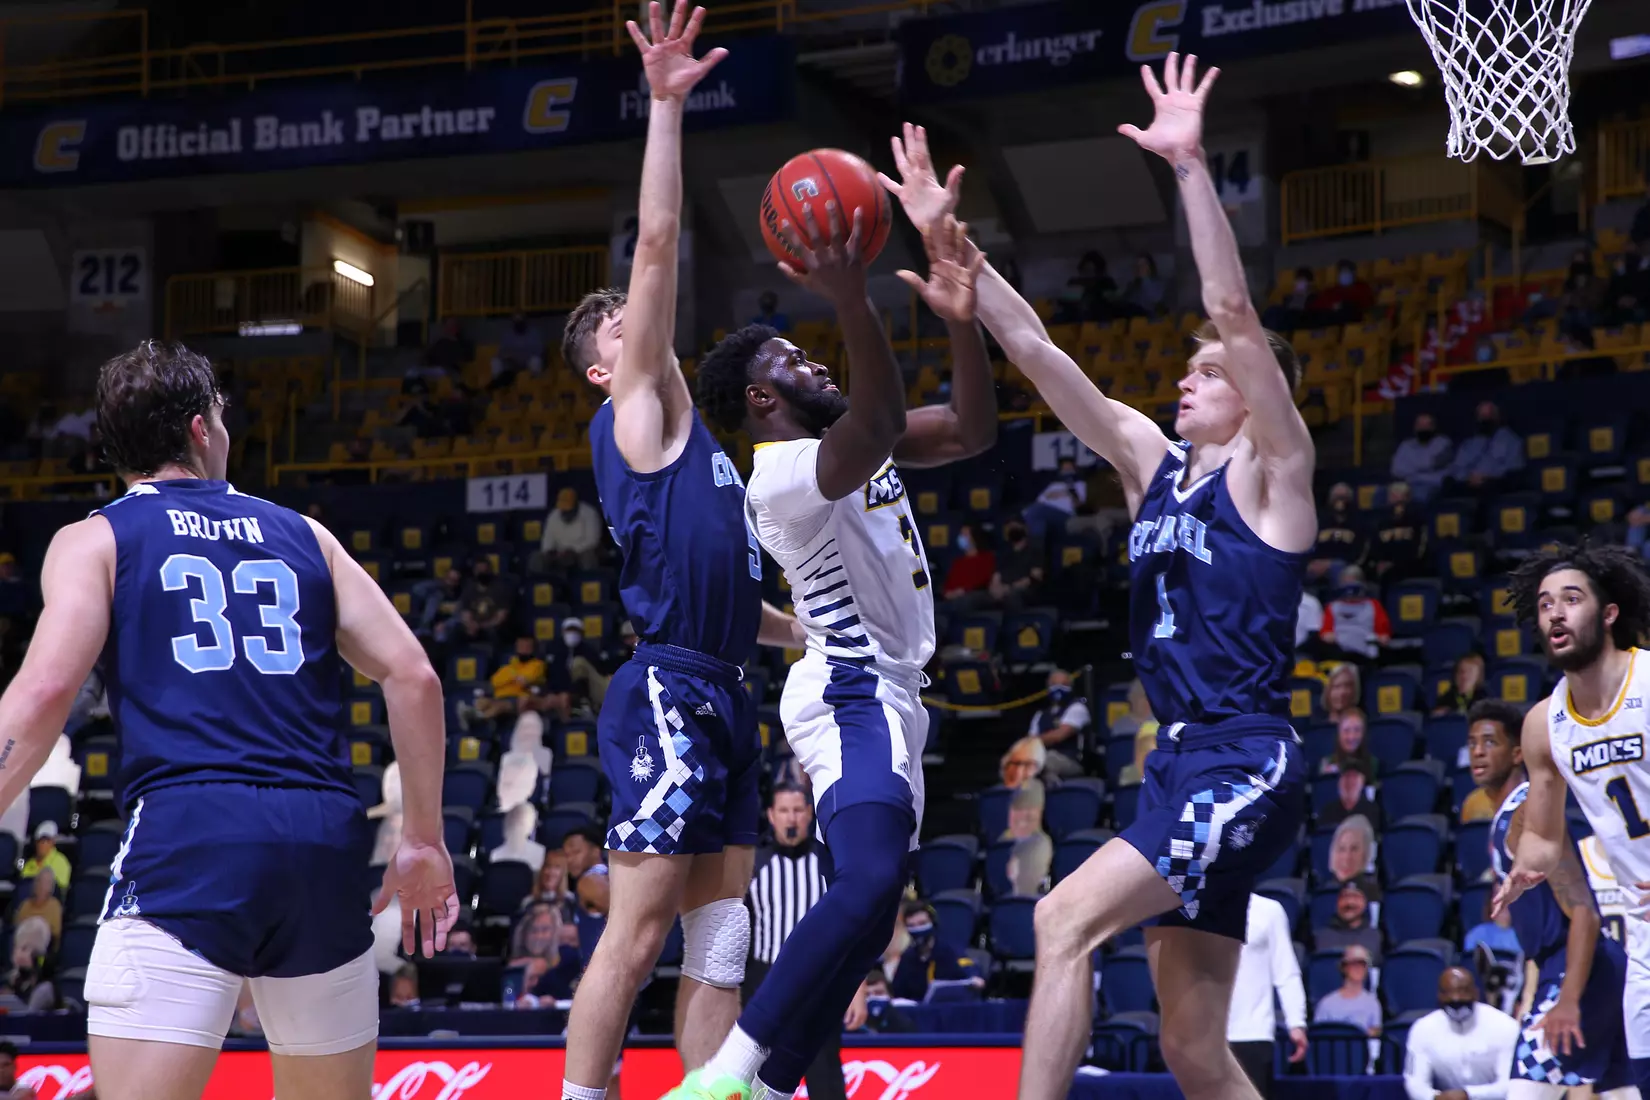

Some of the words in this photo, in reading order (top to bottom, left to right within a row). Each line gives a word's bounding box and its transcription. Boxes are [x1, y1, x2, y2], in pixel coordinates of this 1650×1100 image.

[1200, 0, 1345, 37] Exclusive
[976, 30, 1102, 66] erlanger
[116, 118, 243, 162] Official
[254, 110, 345, 150] Bank
[355, 105, 495, 142] Partner
[79, 254, 140, 296] 212
[484, 480, 530, 507] 114
[159, 553, 306, 675] 33
[1153, 572, 1177, 639] 1
[1573, 737, 1641, 773] MOCS
[1606, 775, 1650, 840] 1
